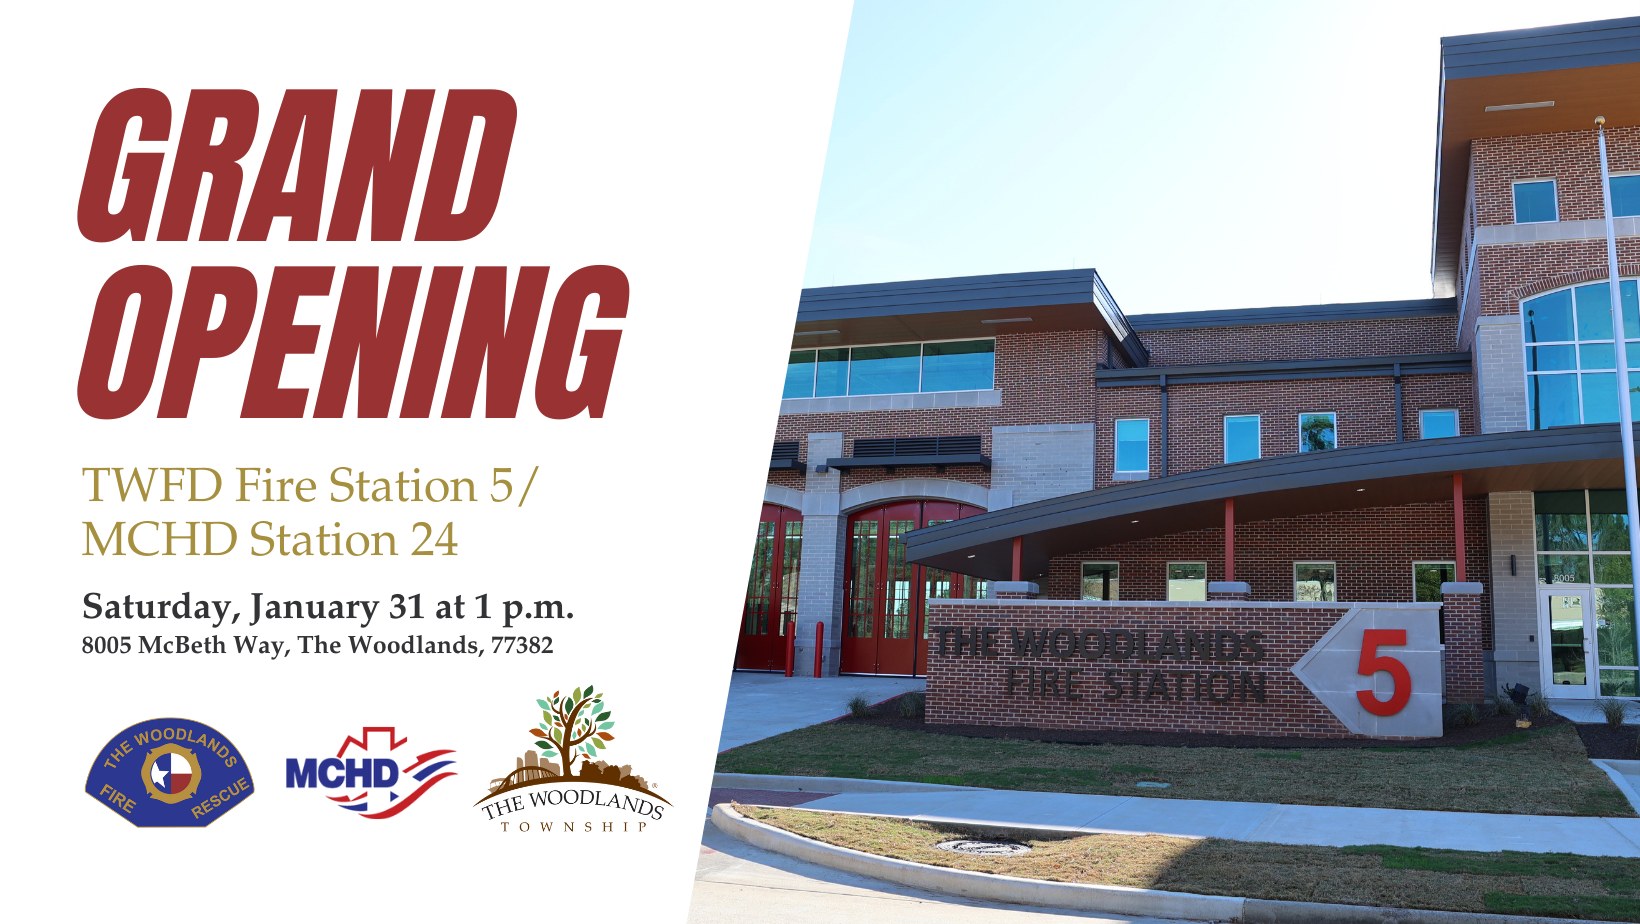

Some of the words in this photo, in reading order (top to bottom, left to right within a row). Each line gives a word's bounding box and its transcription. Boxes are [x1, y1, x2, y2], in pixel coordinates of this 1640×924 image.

[1553, 574, 1575, 582] 8005
[932, 625, 999, 656] THE
[1010, 628, 1265, 663] WOODLANDS
[1006, 666, 1084, 699] FIRE
[1102, 669, 1267, 702] STATION
[1356, 628, 1412, 717] 5
